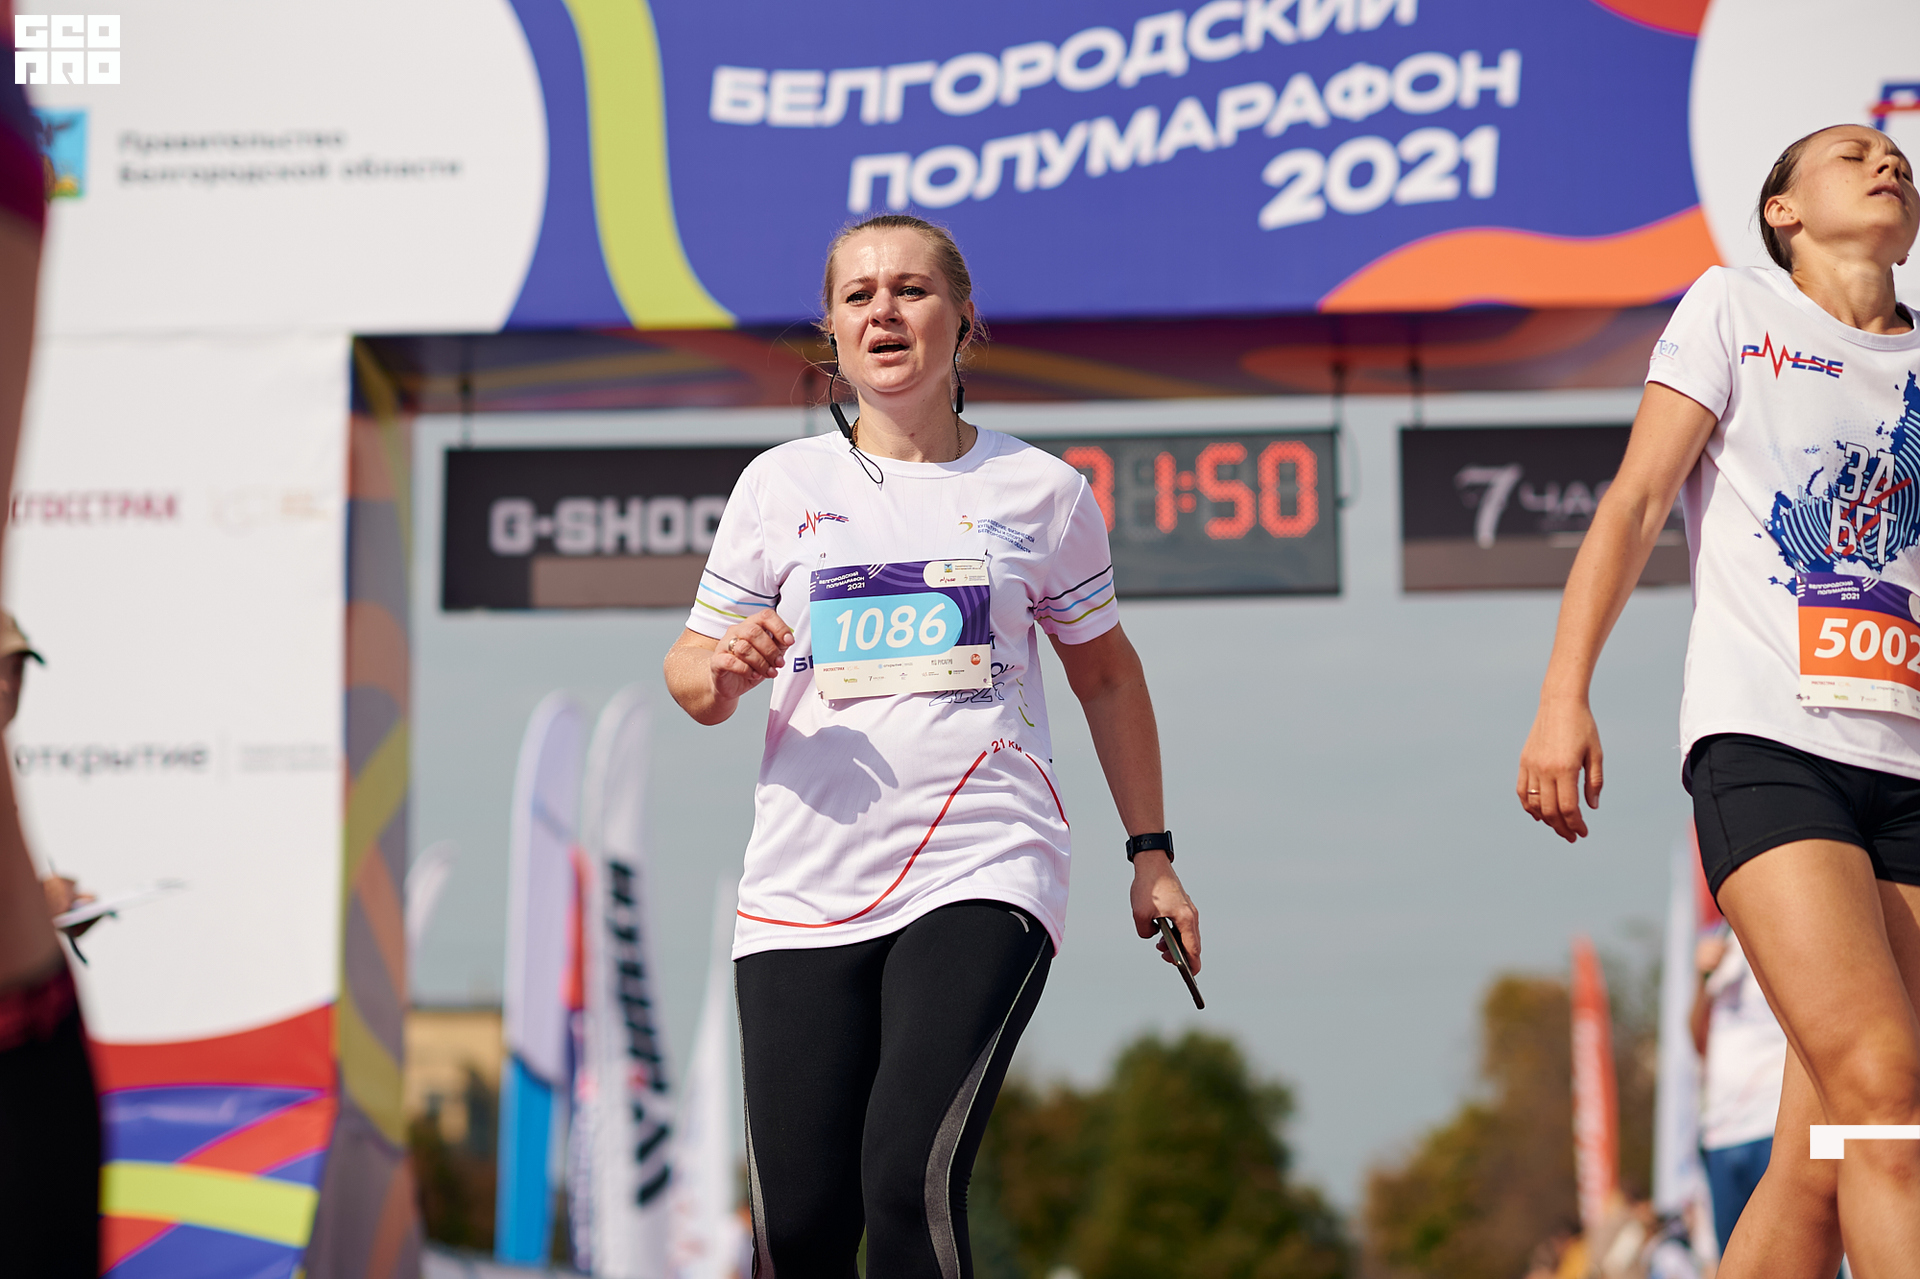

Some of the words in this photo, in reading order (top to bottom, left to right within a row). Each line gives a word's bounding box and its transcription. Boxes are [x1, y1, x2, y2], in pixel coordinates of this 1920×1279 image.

[118, 129, 346, 154] Правительство
[847, 48, 1522, 214] ПОЛУМАРАФОН
[119, 158, 328, 189] Белгородской
[341, 158, 462, 179] области
[1258, 124, 1500, 231] 2021
[1839, 441, 1896, 510] ЗА
[1454, 463, 1523, 549] 7
[1517, 480, 1612, 515] ЧА
[819, 571, 859, 585] БЕЛГОРОДСКИЙ
[826, 576, 865, 589] ПОЛУМАРАФОН
[847, 582, 866, 592] 2021
[1817, 587, 1860, 596] ПОЛУМАРАФОН
[1841, 592, 1860, 601] 2021
[836, 602, 947, 652] 1086
[1814, 617, 1920, 675] 5002
[991, 737, 1006, 754] 21
